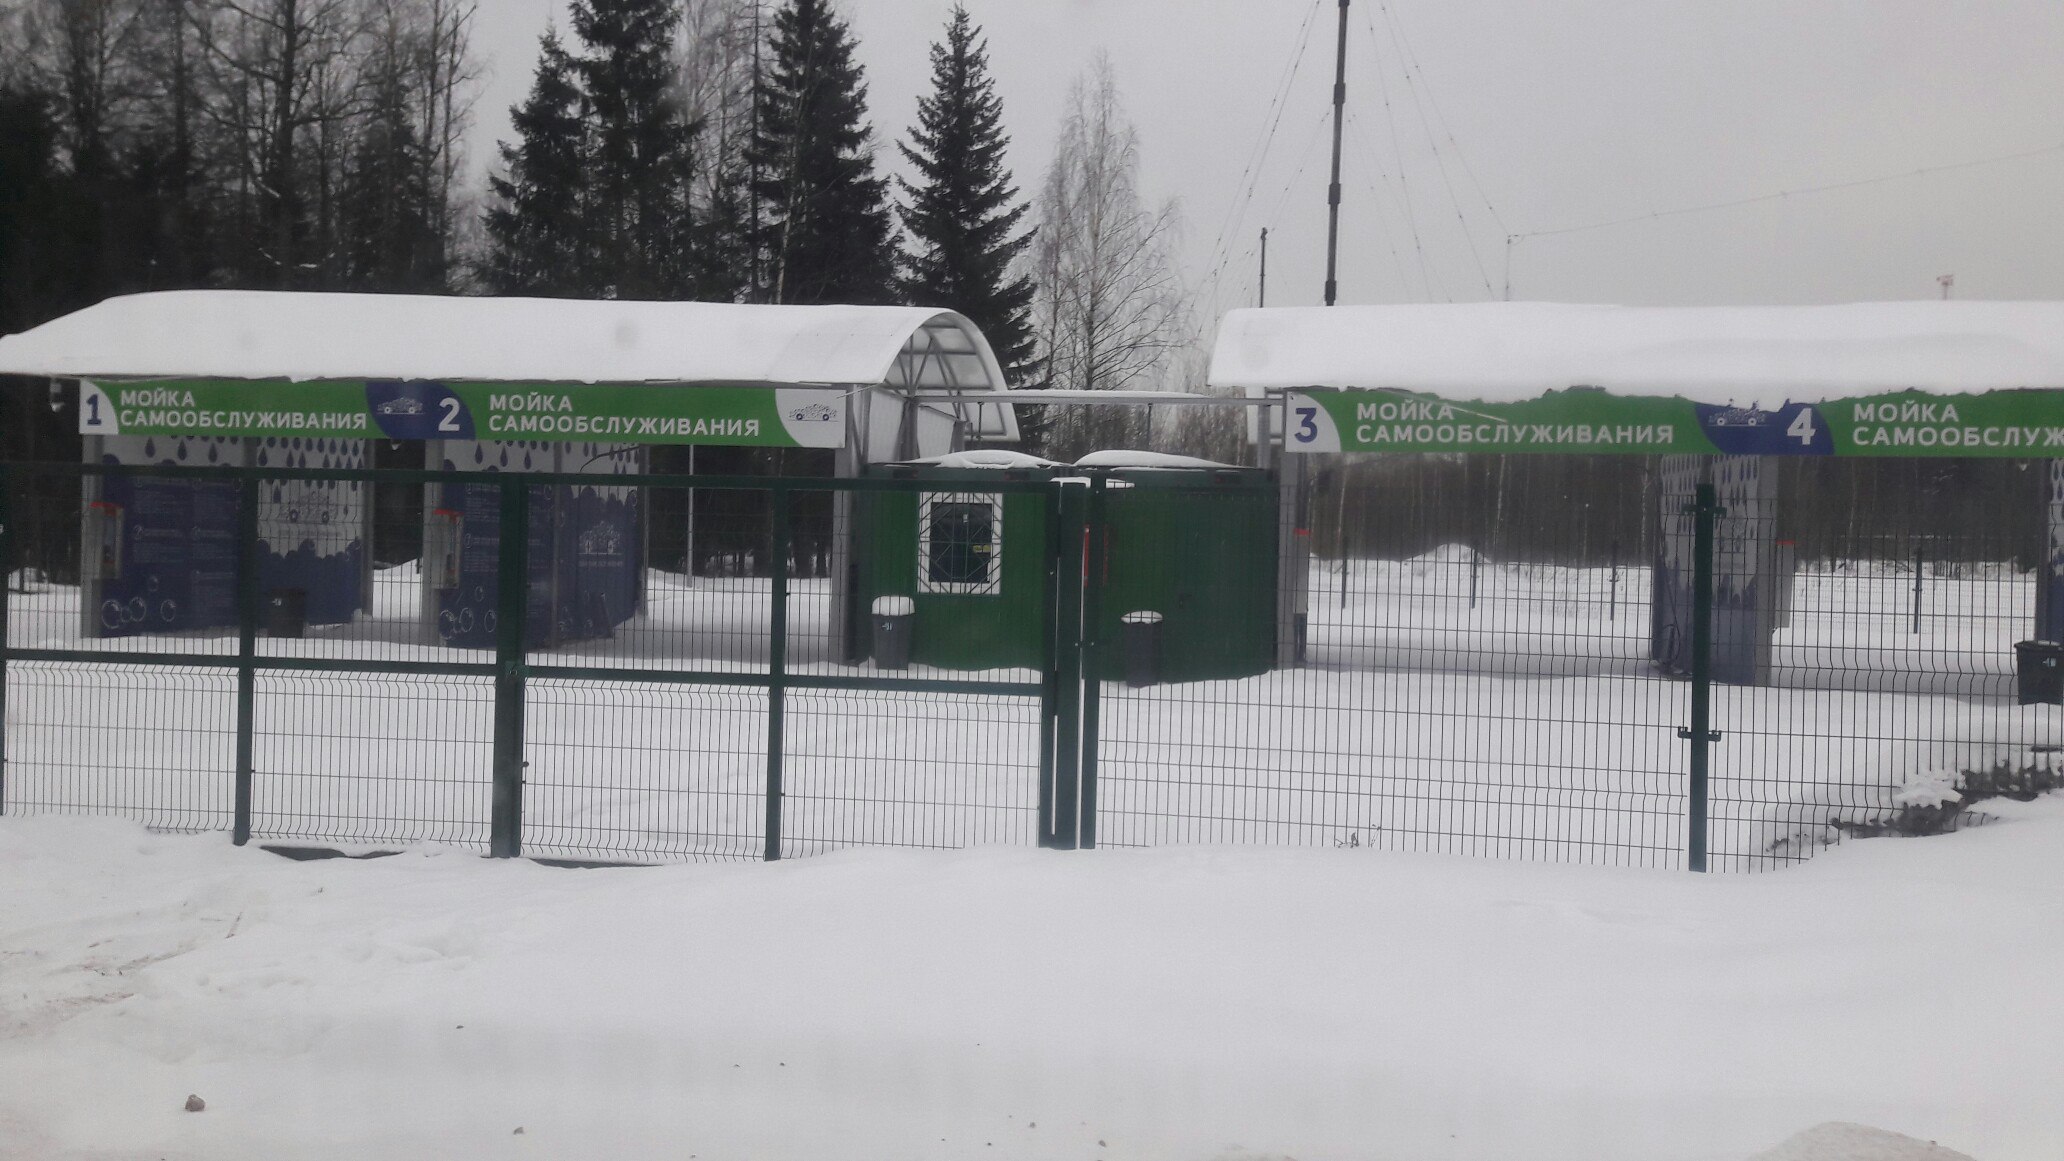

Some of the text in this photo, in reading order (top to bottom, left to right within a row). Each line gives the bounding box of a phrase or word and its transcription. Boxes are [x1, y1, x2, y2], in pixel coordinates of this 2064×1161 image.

[120, 387, 196, 407] МОЙКА
[488, 391, 573, 412] МОЙКА
[87, 394, 103, 425] 1
[120, 410, 368, 430] САМООБСЛУЖИВАНИЯ
[438, 396, 461, 432] 2
[1356, 399, 1454, 421] МОЙКА
[1853, 400, 1960, 422] МОЙКА
[488, 415, 760, 437] САМООБСЛУЖИВАНИЯ
[1294, 407, 1319, 444] 3
[1356, 423, 1674, 445] САМООБСЛУЖИВАНИЯ
[1786, 407, 1817, 445] 4
[1852, 426, 2064, 447] САМООБСЛУЖ
